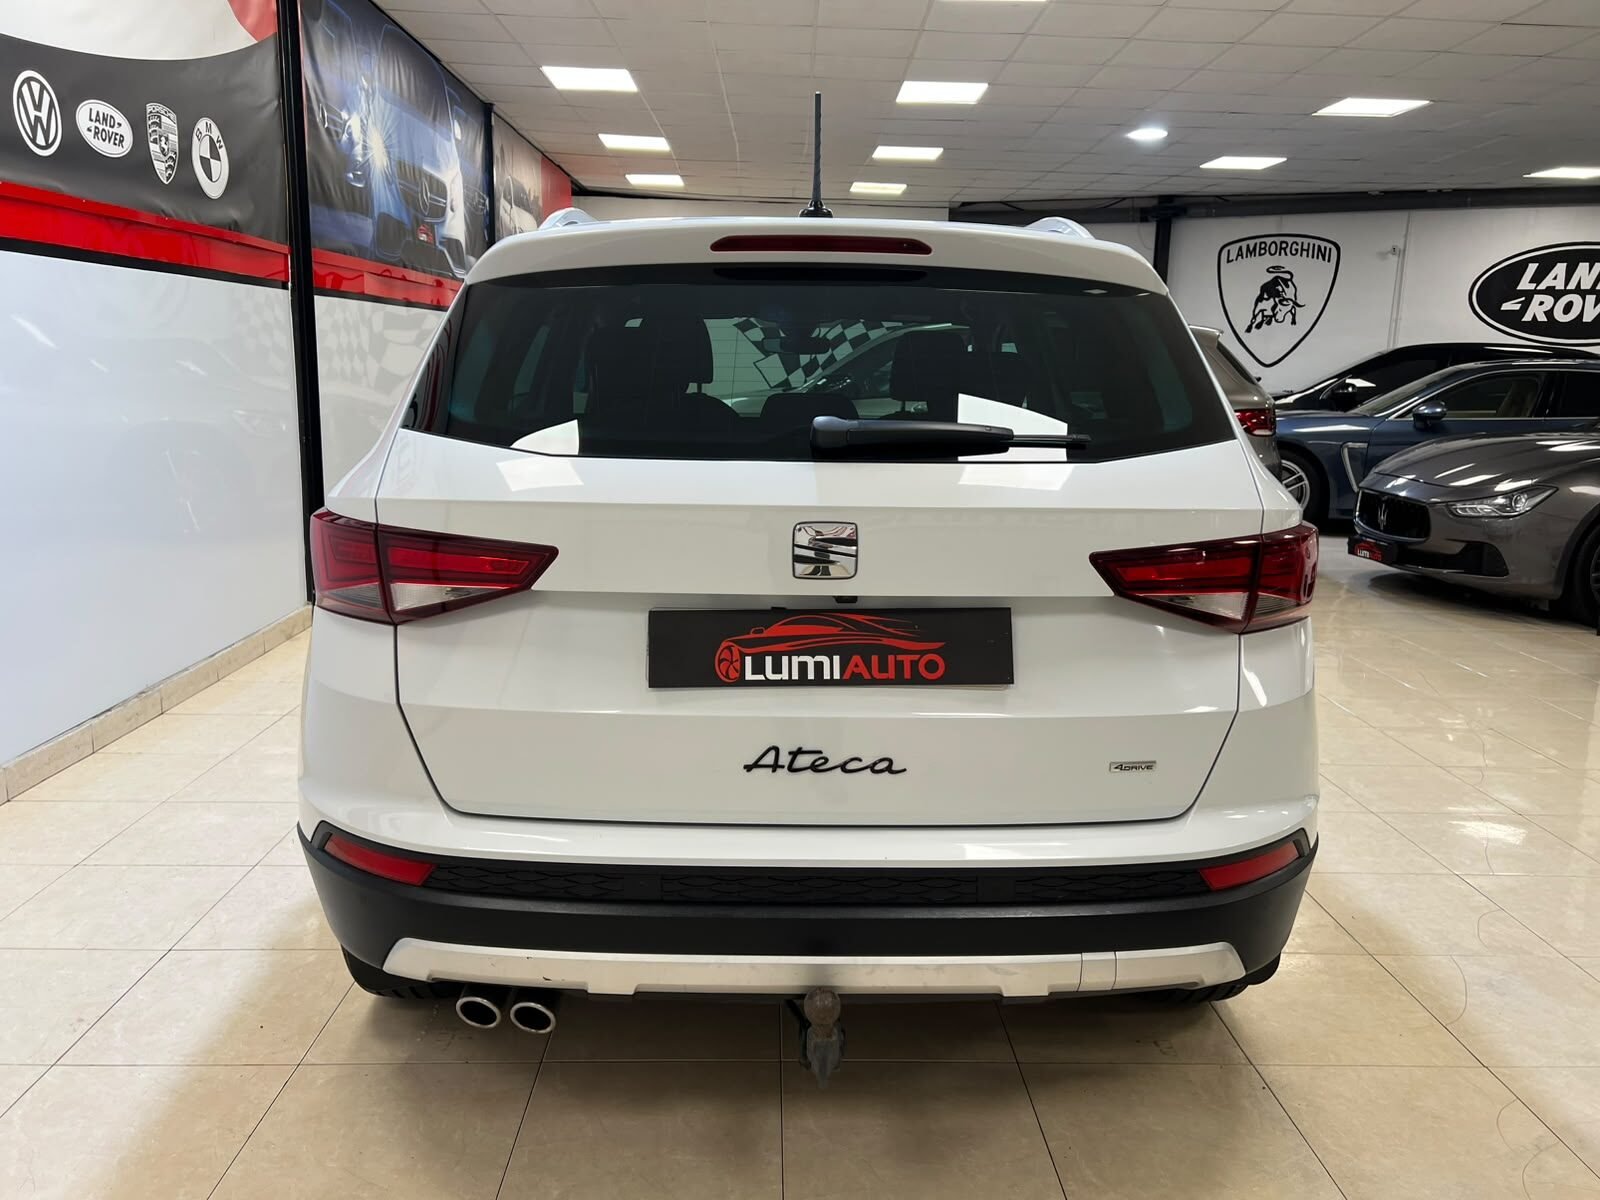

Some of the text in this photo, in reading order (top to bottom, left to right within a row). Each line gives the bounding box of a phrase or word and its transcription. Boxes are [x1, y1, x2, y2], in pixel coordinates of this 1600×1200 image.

[88, 107, 116, 129] LAND
[93, 125, 125, 149] ROVER
[195, 121, 224, 149] BMW
[1226, 240, 1332, 264] LAMBORGHINI
[1516, 262, 1600, 290] LAN
[743, 745, 907, 775] Ateca
[1113, 763, 1155, 772] 4DRIVE
